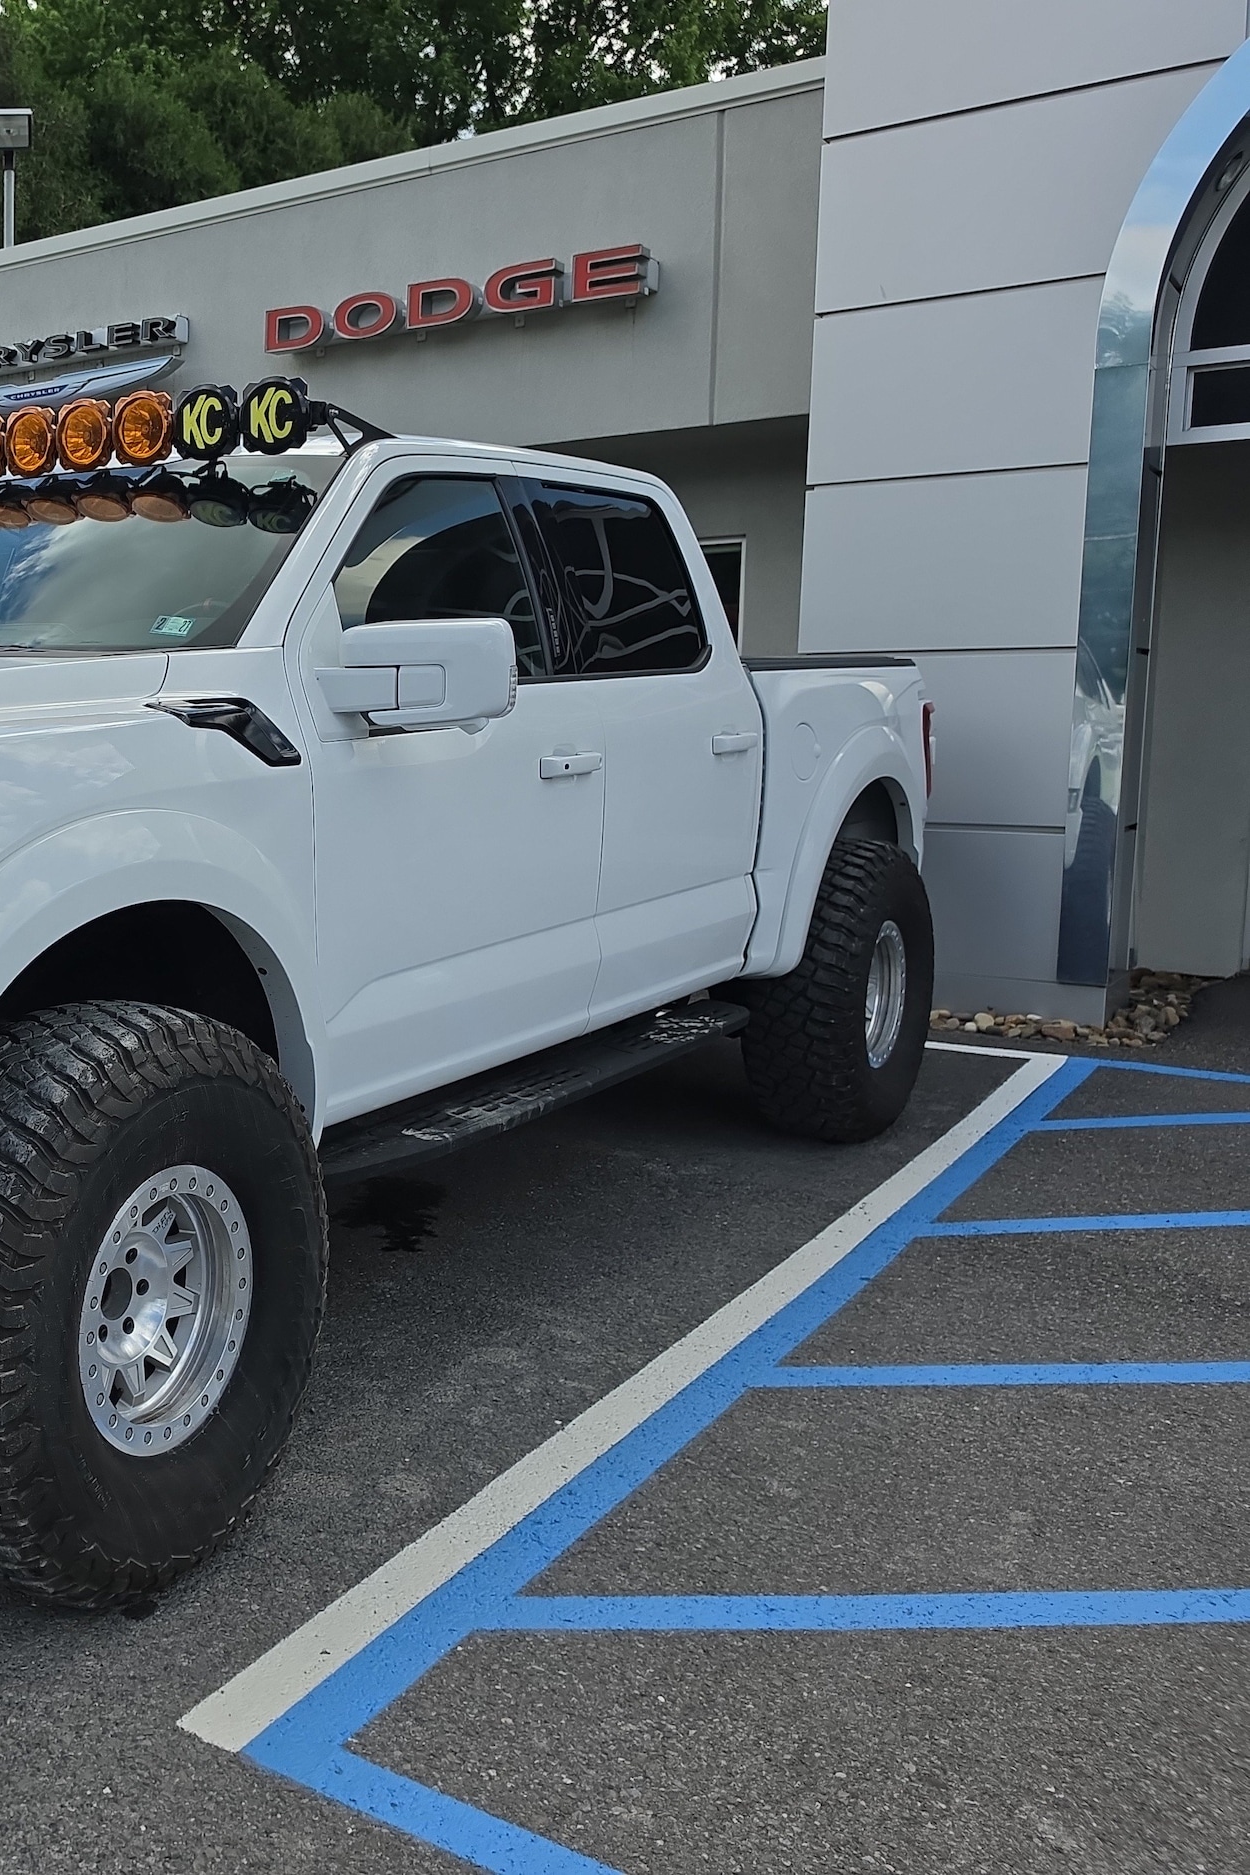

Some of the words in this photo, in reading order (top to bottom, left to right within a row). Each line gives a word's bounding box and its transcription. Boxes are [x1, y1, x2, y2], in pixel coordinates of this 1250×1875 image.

[264, 244, 650, 355] DODGE
[10, 387, 60, 400] CHRYSLER
[250, 387, 293, 443] KC
[183, 394, 222, 449] KC
